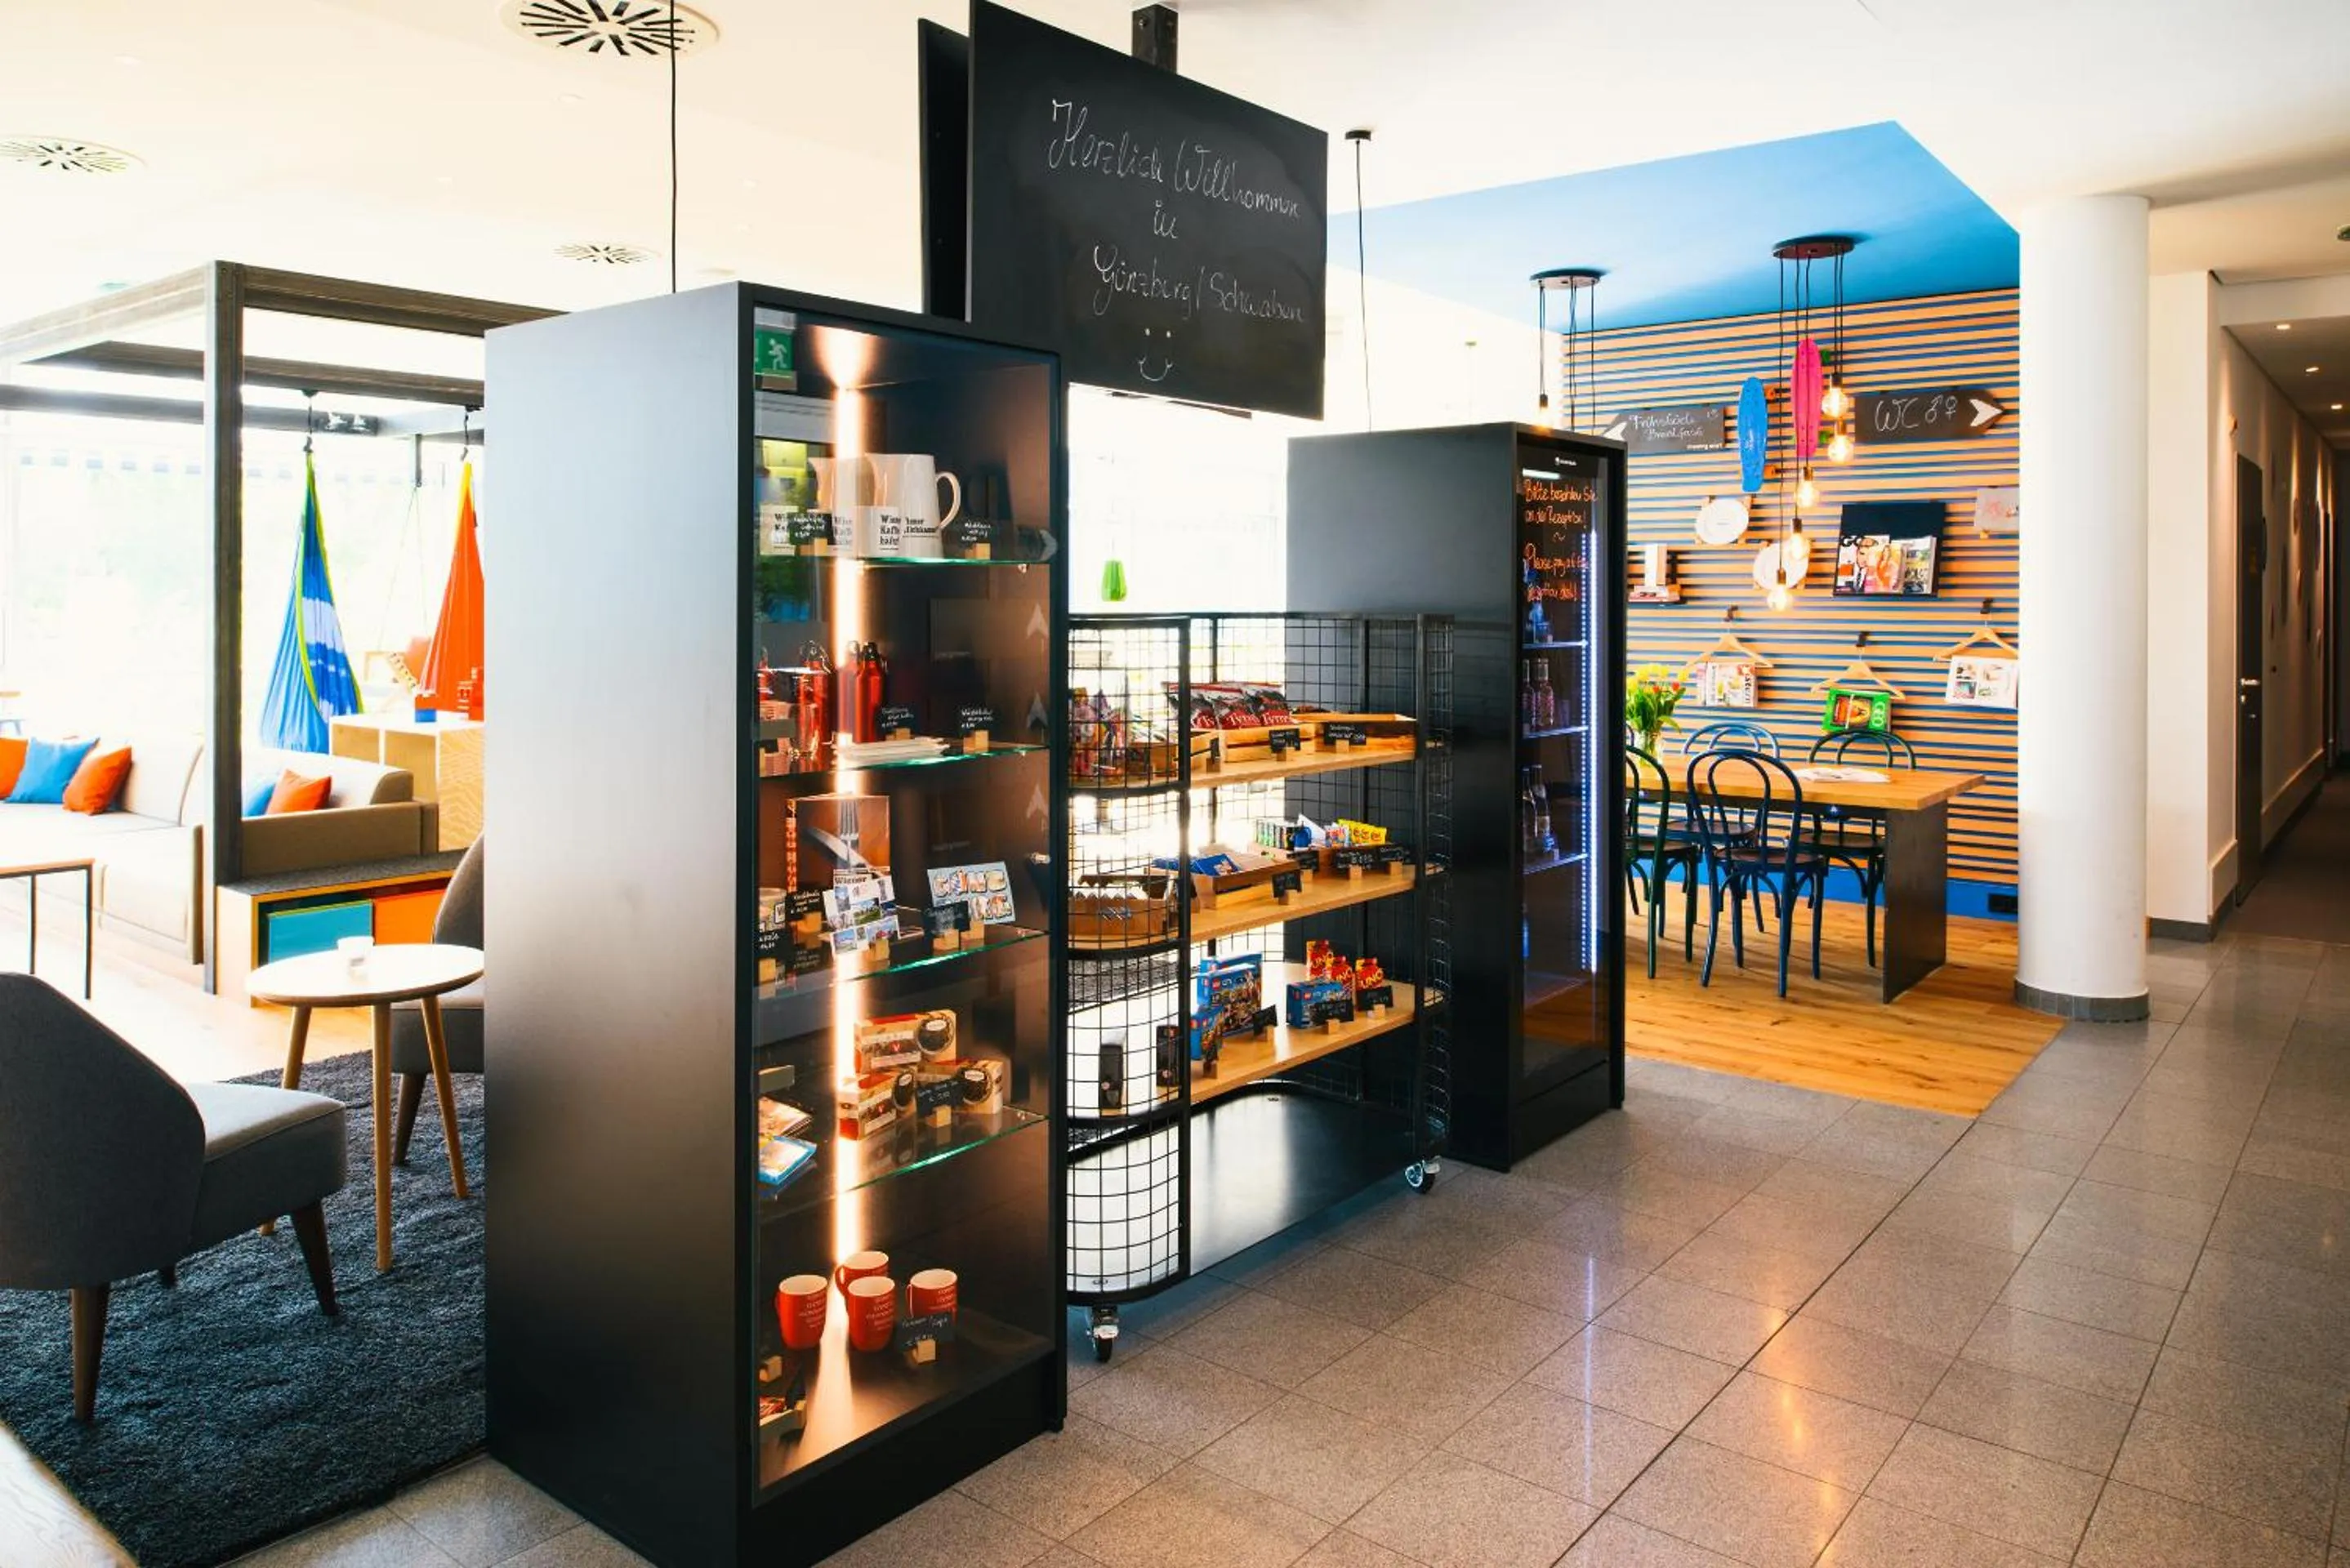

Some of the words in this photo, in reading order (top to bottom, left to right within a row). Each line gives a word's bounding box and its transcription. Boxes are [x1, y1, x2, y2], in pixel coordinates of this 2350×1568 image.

[1049, 99, 1163, 183] Herzlich
[1153, 199, 1178, 239] in
[1875, 398, 1919, 432] WC
[1360, 967, 1385, 989] UNO
